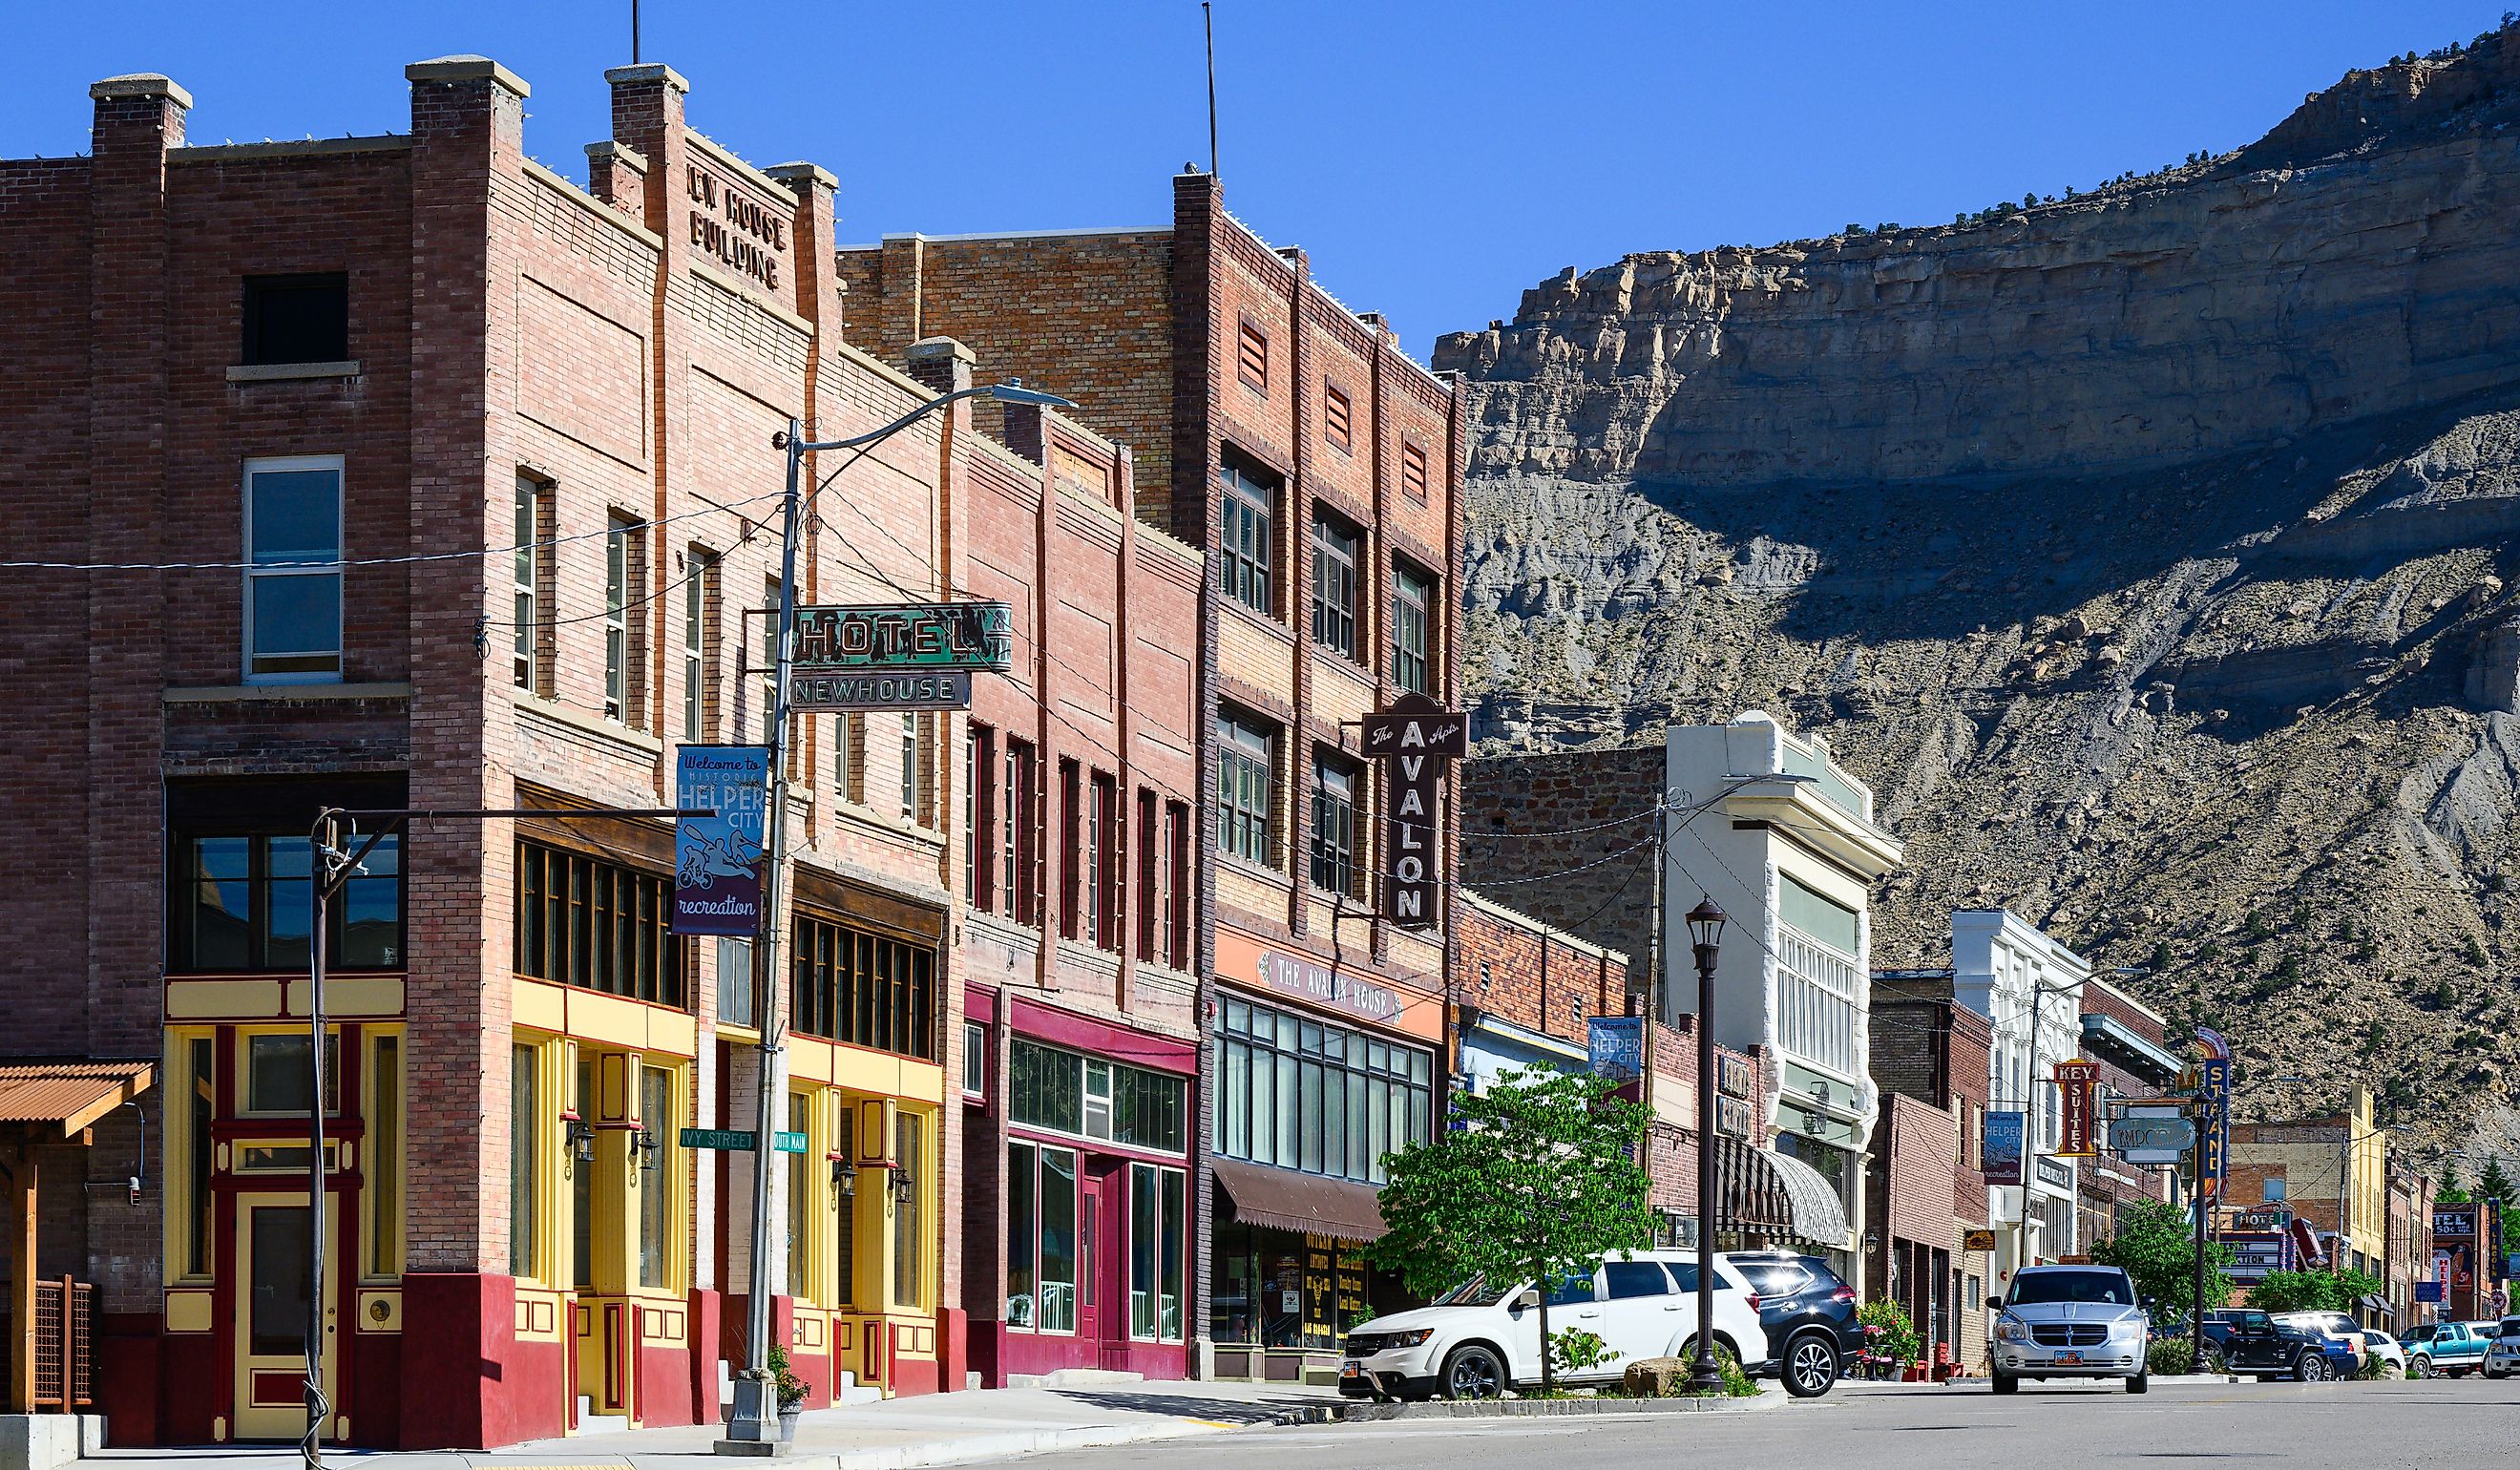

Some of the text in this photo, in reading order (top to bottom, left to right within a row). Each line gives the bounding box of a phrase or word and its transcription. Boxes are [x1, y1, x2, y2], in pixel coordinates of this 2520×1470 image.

[725, 189, 787, 252] HOUSE
[690, 210, 779, 291] BUILDING
[800, 617, 977, 657] HOTEL
[794, 677, 956, 703] NEWHOUSE
[684, 755, 761, 770] Welcome to
[679, 784, 764, 810] HELPER
[727, 811, 764, 829] CITY
[1371, 724, 1394, 746] The
[1396, 721, 1426, 917] AVALON
[679, 893, 756, 916] recreation
[1277, 958, 1300, 989] THE
[1354, 984, 1387, 1016] HOUSE
[1592, 1021, 1628, 1030] Welcome
[1589, 1039, 1640, 1052] HELPER
[1618, 1053, 1640, 1063] CITY
[2058, 1066, 2093, 1081] KEY
[2069, 1082, 2082, 1152] SUITES
[682, 1130, 752, 1148] IVY STREET
[1985, 1126, 2022, 1137] HELPER
[774, 1133, 806, 1150] OUTH MAIN
[1985, 1168, 2020, 1178] recreation
[2239, 1214, 2285, 1226] HOTE
[2433, 1214, 2467, 1226] TEL
[2439, 1259, 2448, 1300] HELPER
